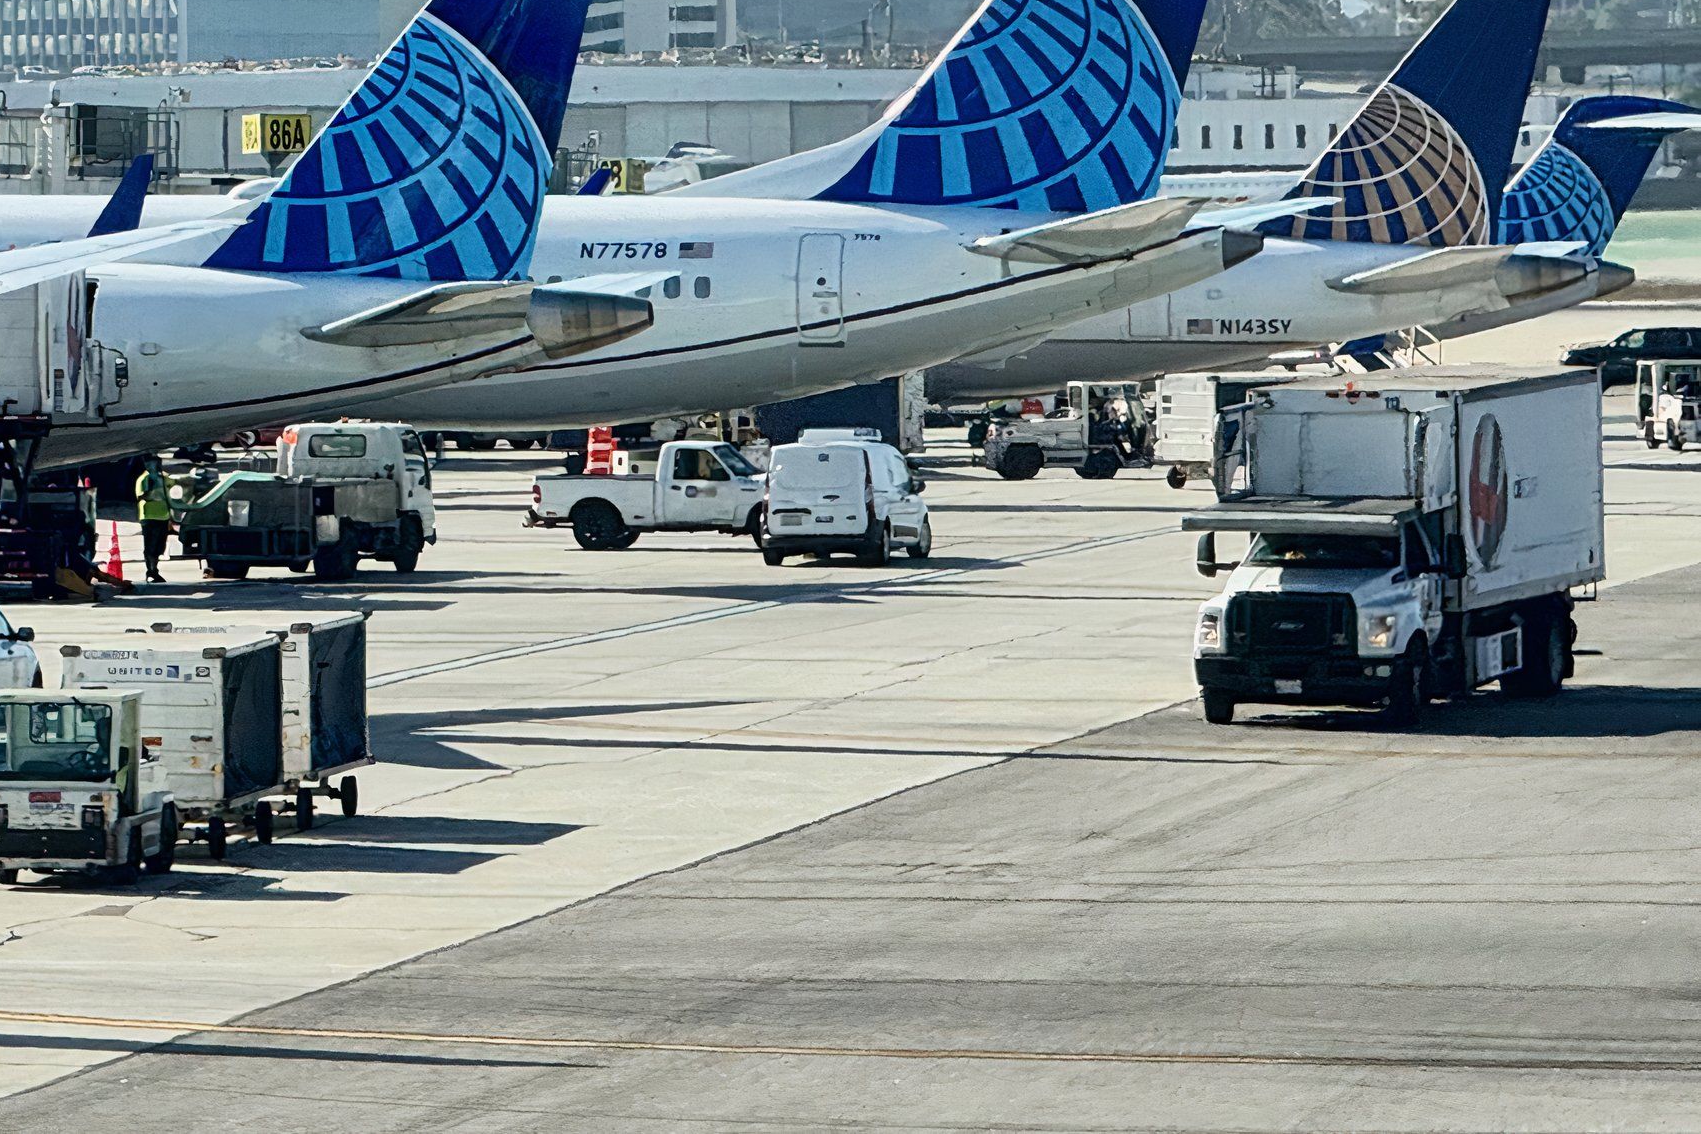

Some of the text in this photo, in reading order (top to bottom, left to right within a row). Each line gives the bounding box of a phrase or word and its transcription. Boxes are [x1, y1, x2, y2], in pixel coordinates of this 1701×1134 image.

[270, 119, 306, 150] 86A
[580, 242, 667, 259] N77578
[1219, 319, 1292, 334] N143SY
